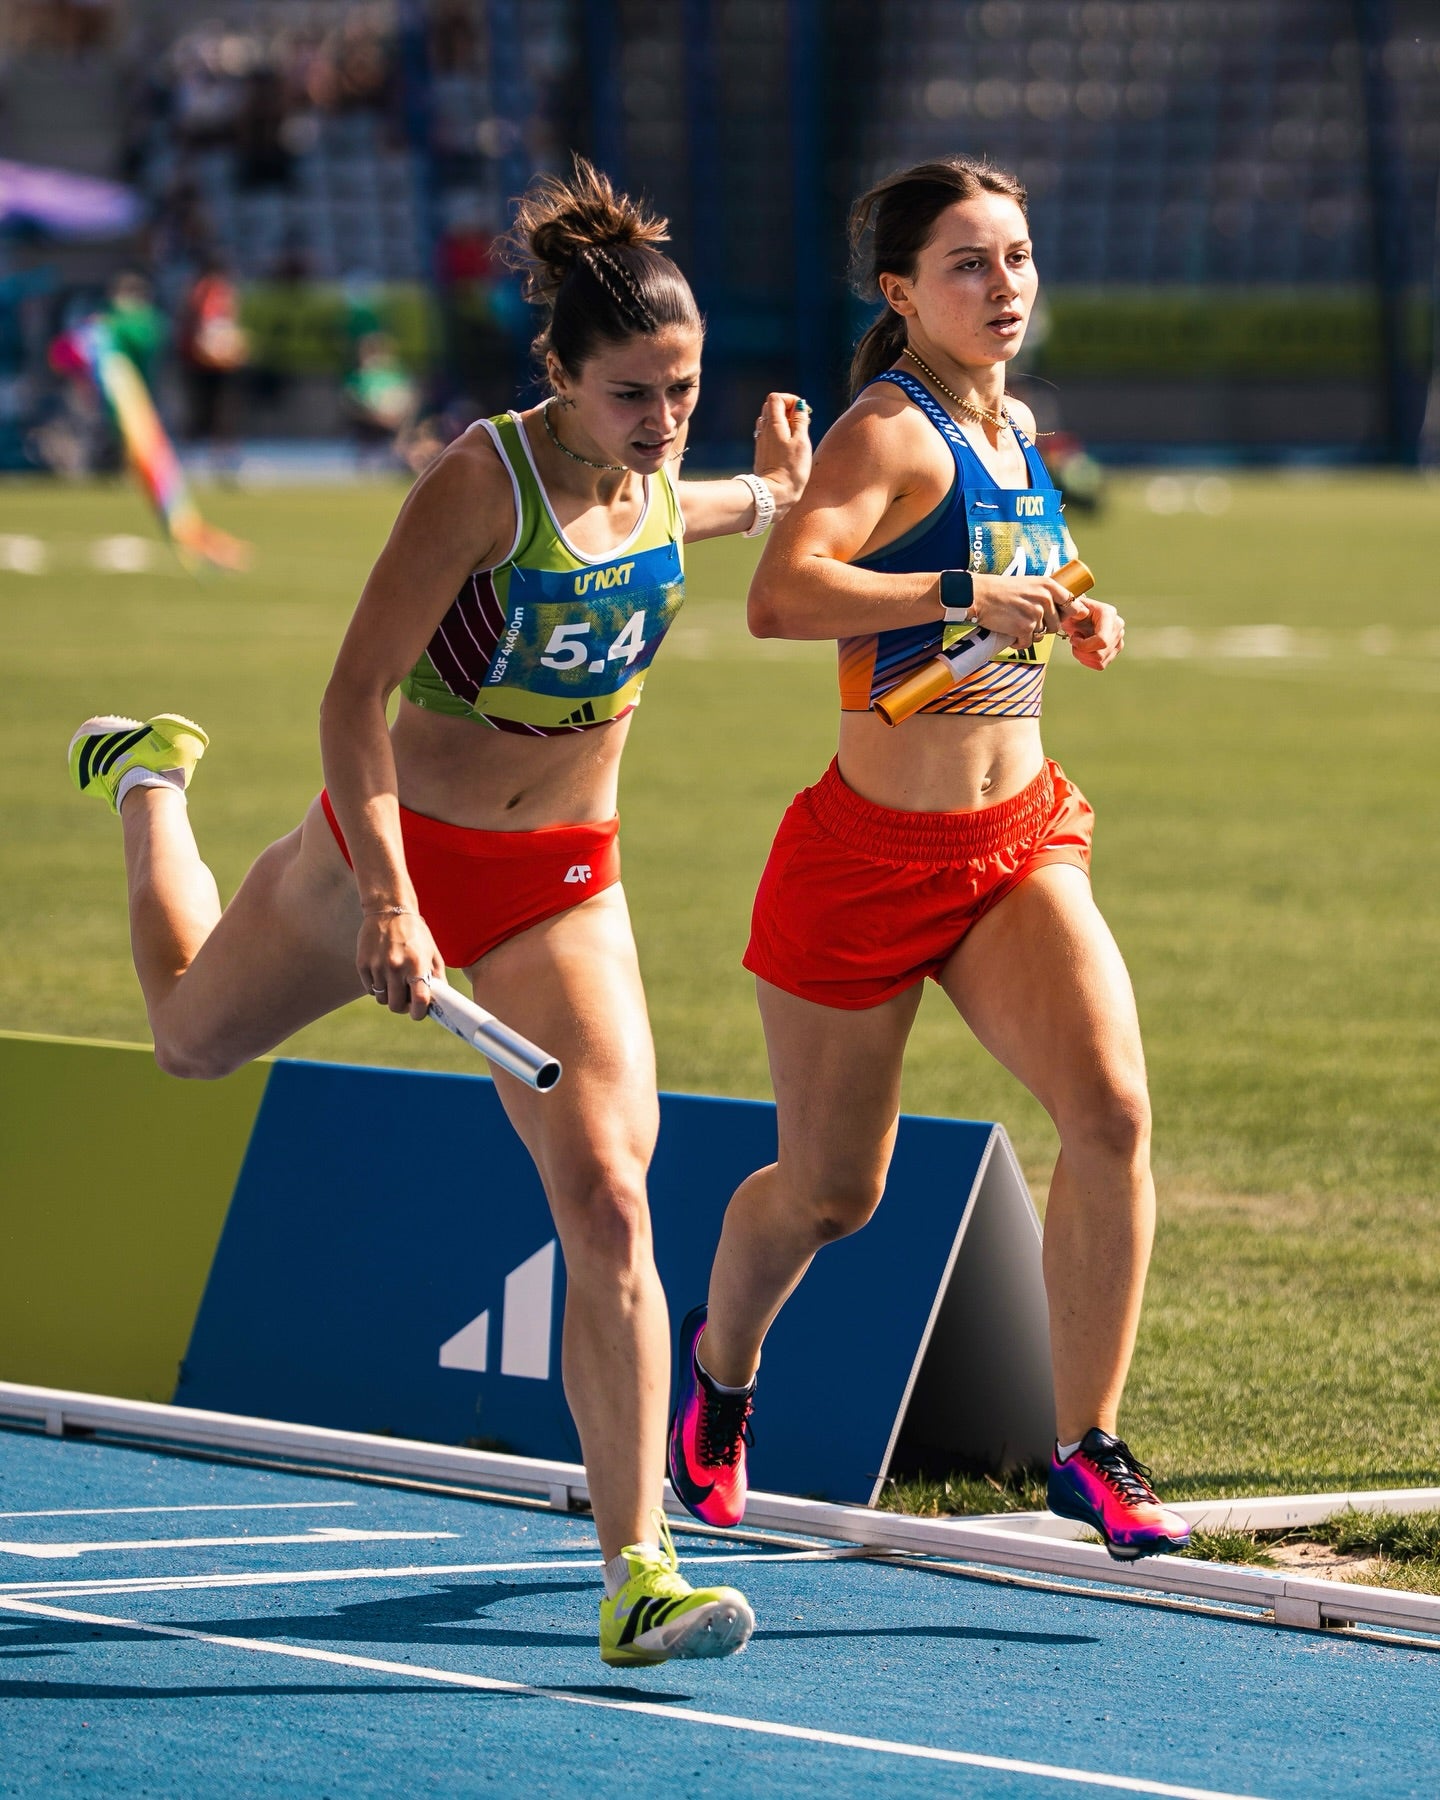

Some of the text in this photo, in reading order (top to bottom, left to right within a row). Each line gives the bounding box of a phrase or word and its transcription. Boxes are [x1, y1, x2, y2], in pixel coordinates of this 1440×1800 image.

[489, 606, 525, 683] U23F 4x400m
[540, 609, 646, 674] 5.4
